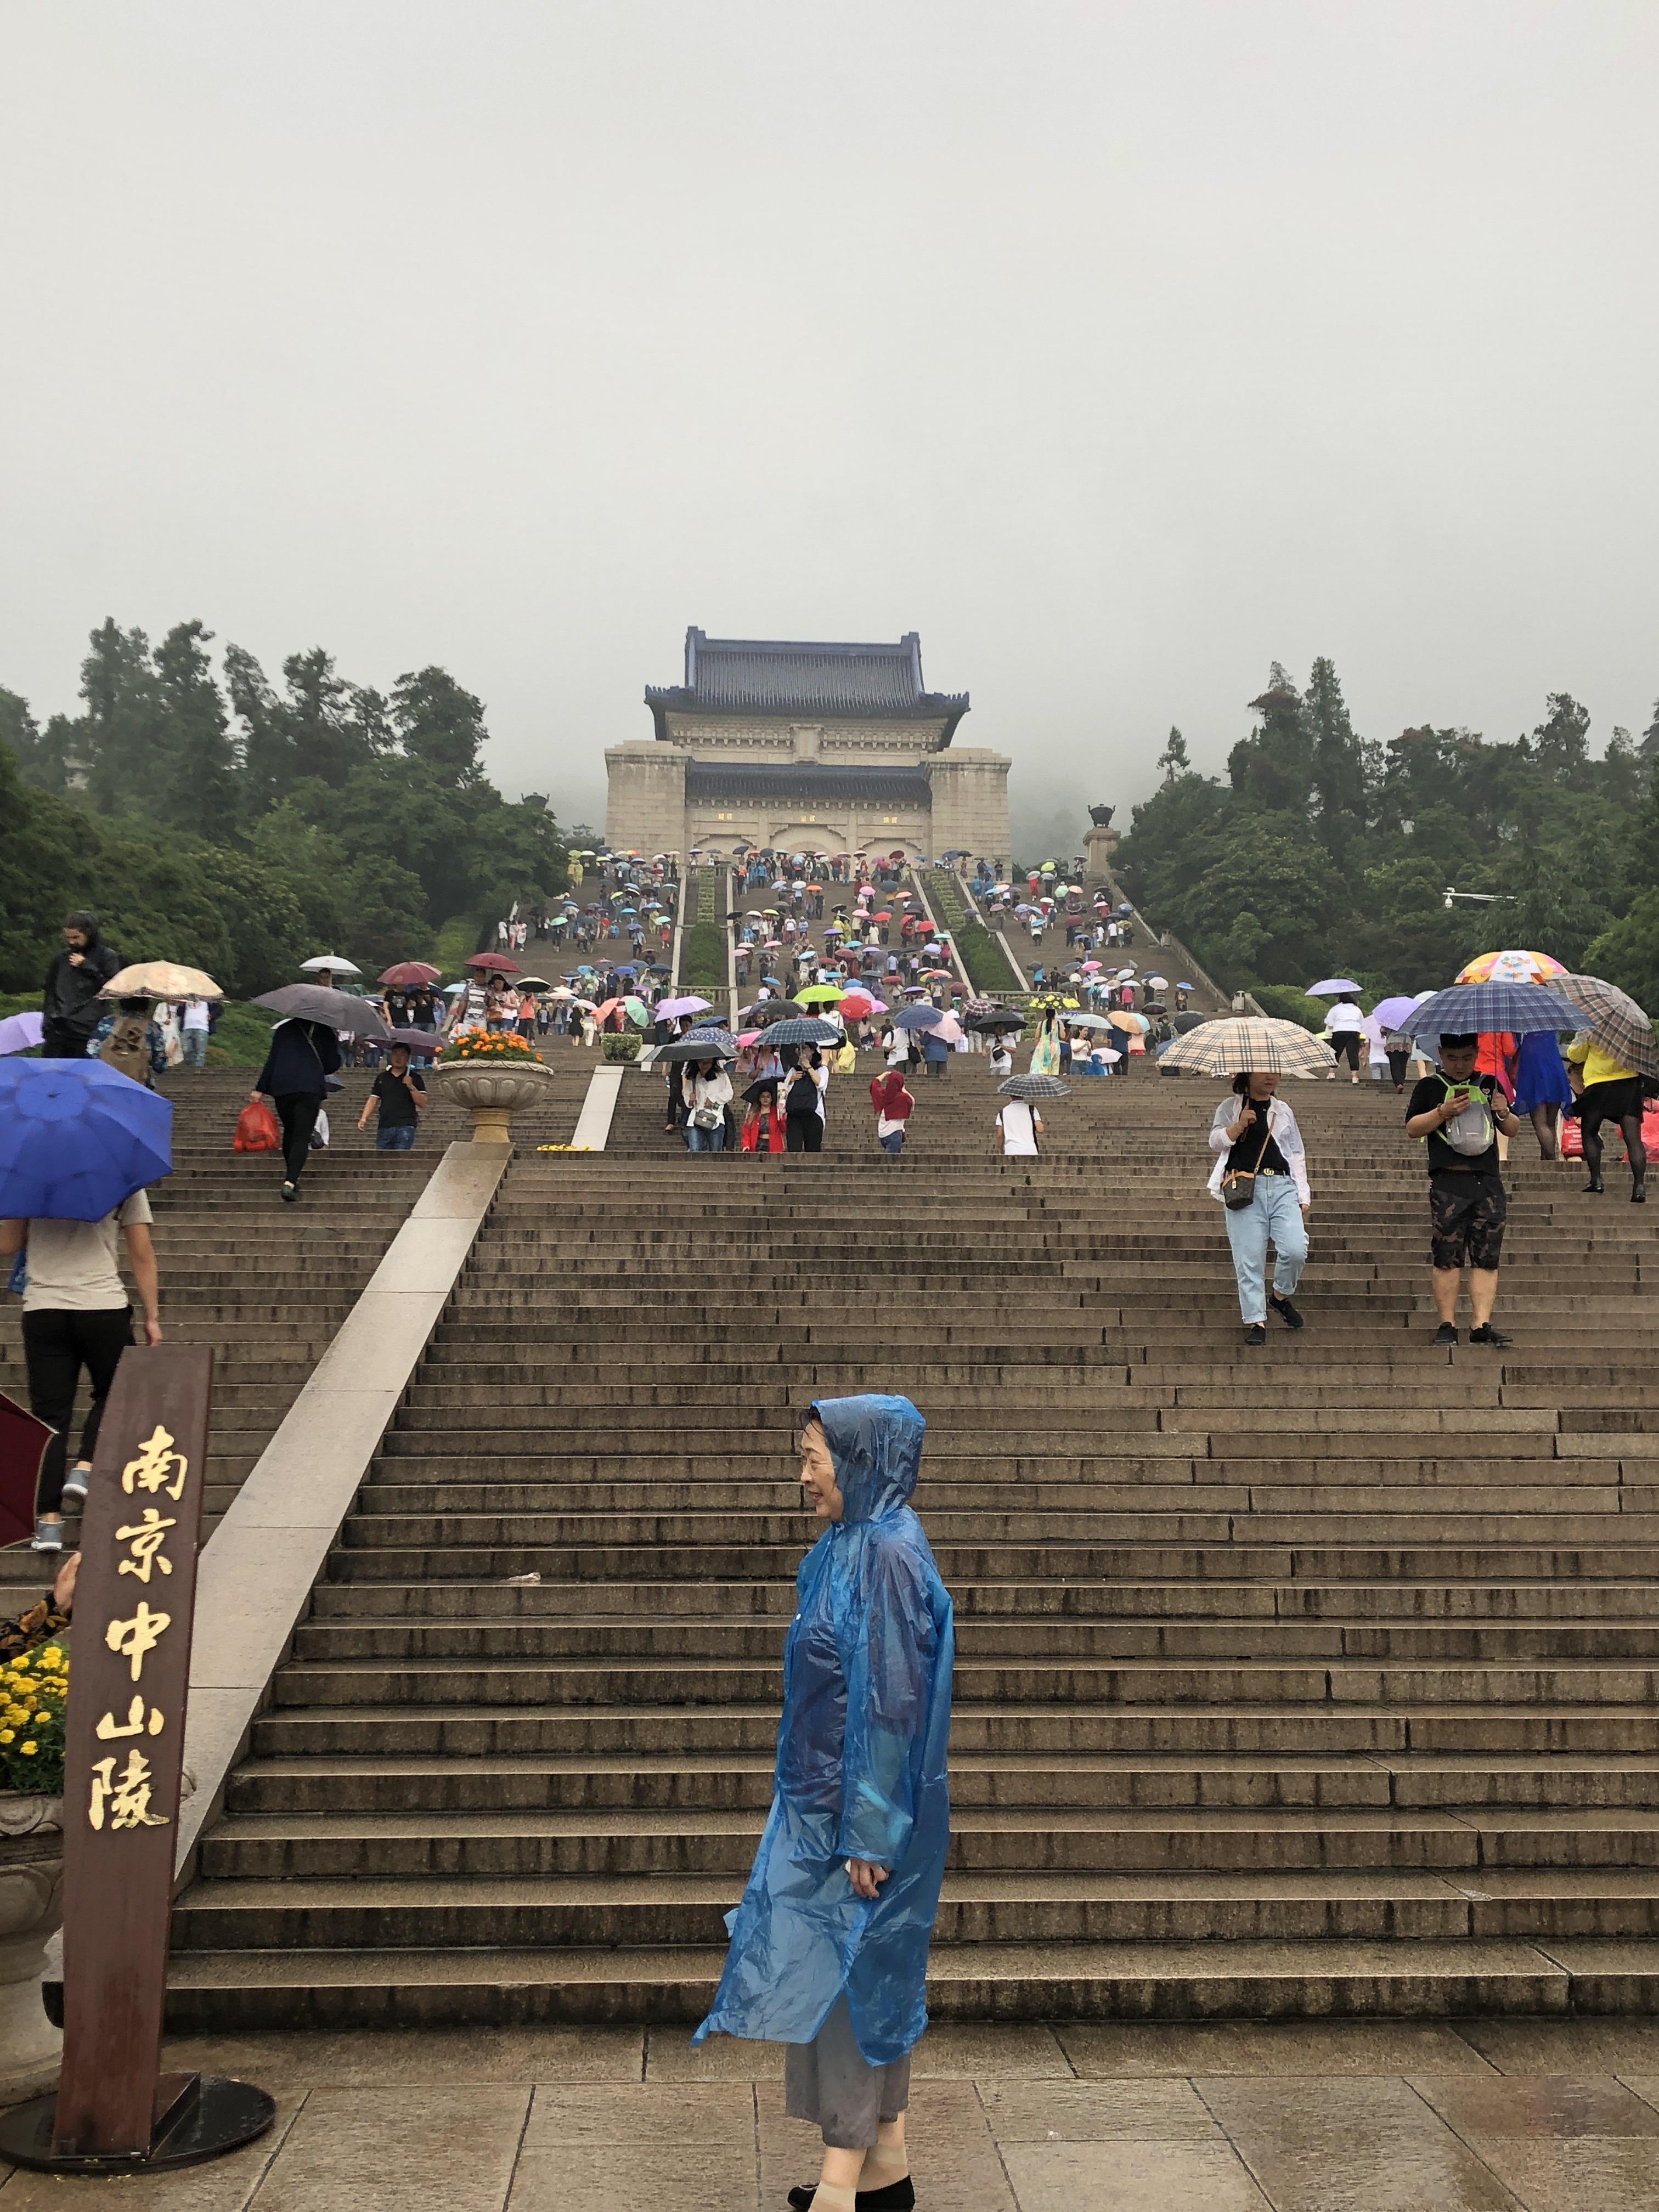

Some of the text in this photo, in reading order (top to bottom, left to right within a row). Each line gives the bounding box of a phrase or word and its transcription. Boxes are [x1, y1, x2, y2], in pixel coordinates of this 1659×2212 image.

[88, 1425, 188, 1830] 南京中山陵
